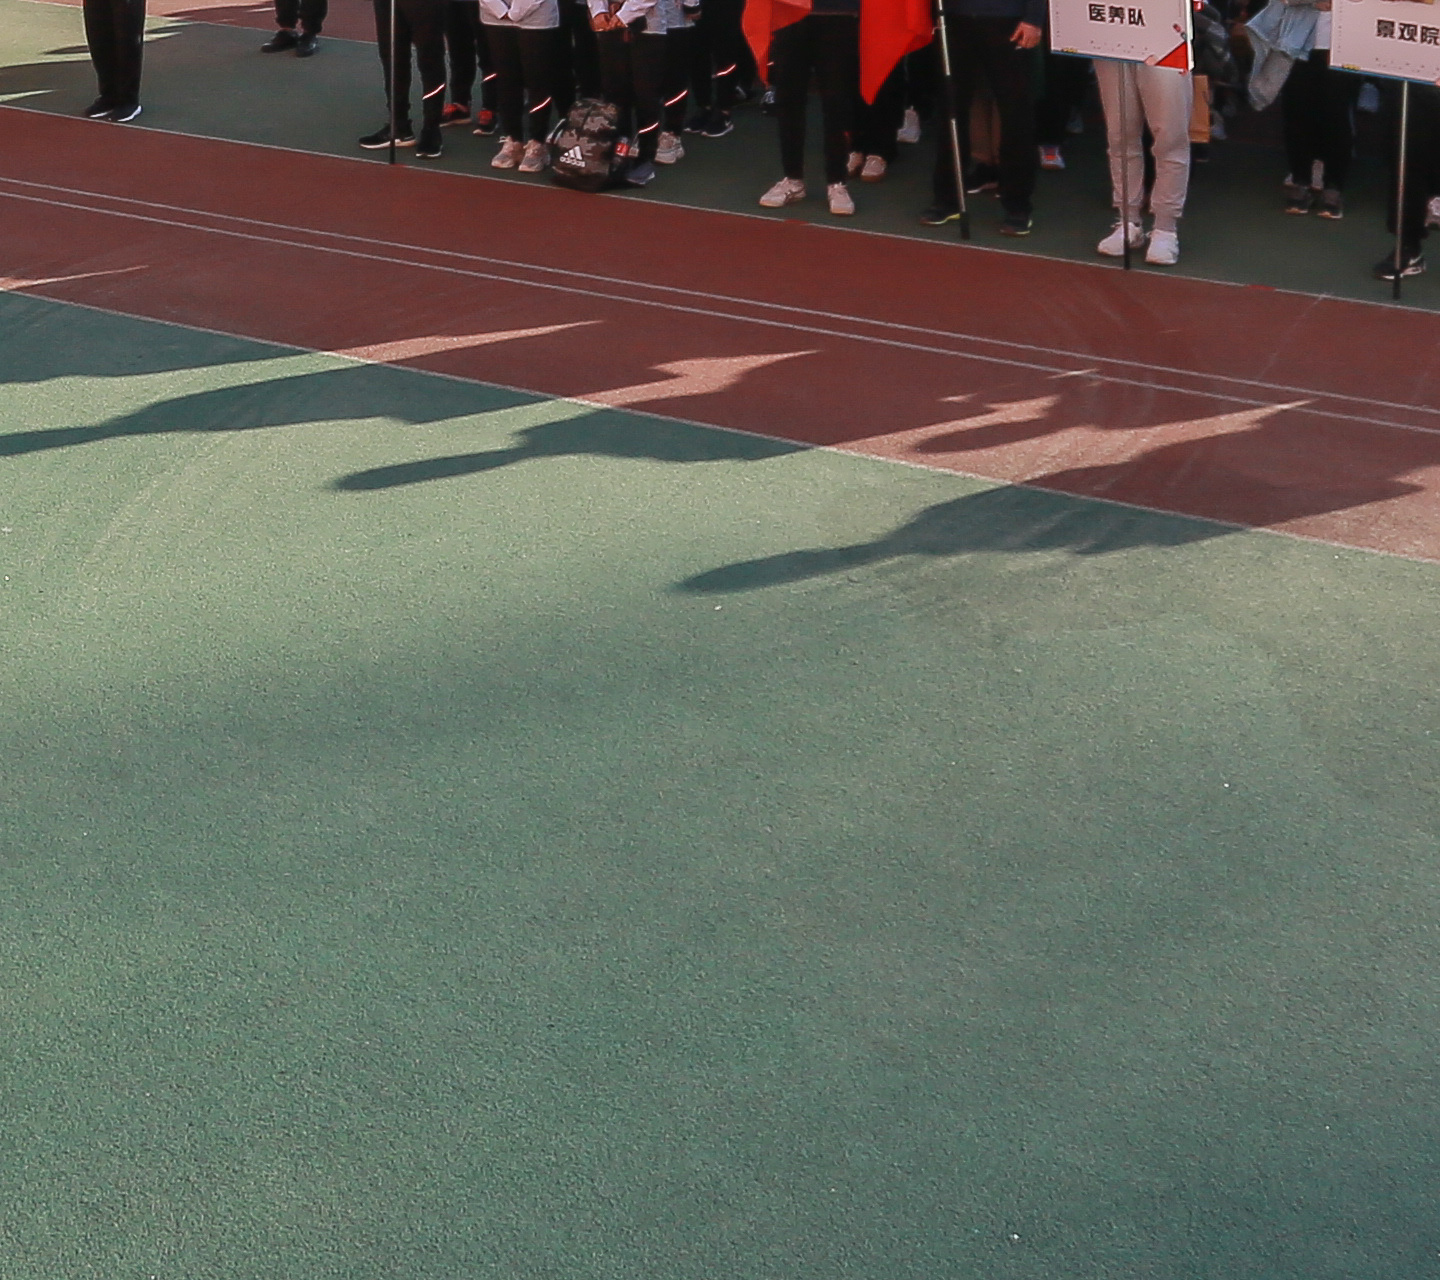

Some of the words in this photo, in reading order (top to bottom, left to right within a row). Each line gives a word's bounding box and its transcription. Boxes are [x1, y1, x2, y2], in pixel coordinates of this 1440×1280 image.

[1088, 3, 1146, 27] 医养队
[1376, 19, 1440, 46] 景观院
